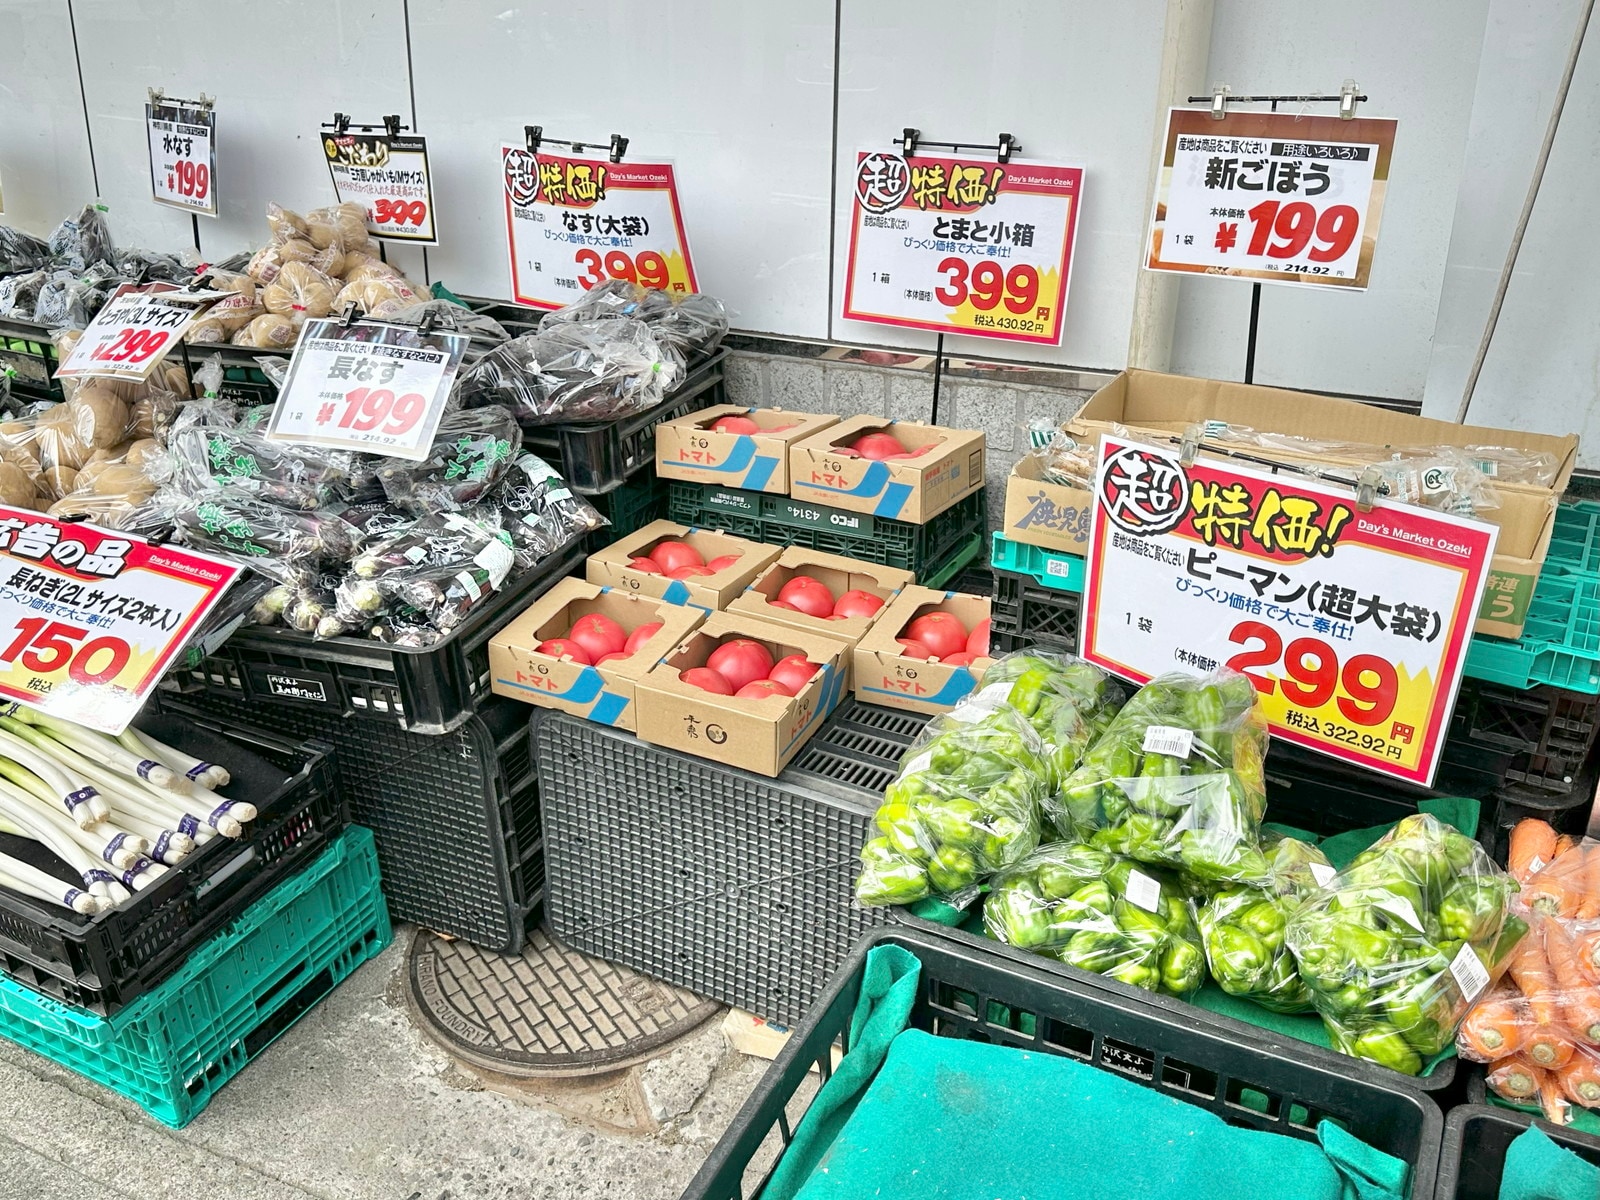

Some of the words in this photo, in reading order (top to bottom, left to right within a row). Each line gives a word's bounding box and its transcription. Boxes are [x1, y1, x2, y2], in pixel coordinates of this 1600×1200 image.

[163, 134, 193, 157] 水なす
[1178, 137, 1268, 155] 産地は商品をご覧ください
[504, 150, 538, 200] 超
[610, 172, 625, 180] Day's
[858, 154, 908, 209] 超
[1008, 175, 1026, 184] Day's
[1027, 176, 1052, 185] Market
[1053, 178, 1073, 187] Ozeki
[1204, 156, 1330, 196] 新ごぼう
[562, 211, 649, 236] なす(大袋)
[1209, 207, 1245, 219] 本体価格
[544, 230, 633, 247] びっくり価格で大ご奉仕!
[932, 216, 1035, 248] とまと小箱
[1175, 234, 1180, 244] 1
[1184, 234, 1195, 246] 袋
[903, 236, 1011, 258] びっくり価格で大ご奉仕!
[872, 272, 877, 282] 1
[880, 273, 890, 284] 箱
[1284, 263, 1330, 275] 214.92
[903, 289, 934, 302] (本体価格)
[327, 355, 404, 385] 長なす
[318, 391, 344, 401] 本体価格
[362, 434, 397, 445] 214.92
[680, 449, 716, 464] トマト
[811, 471, 848, 488] トマト
[1102, 449, 1186, 534] 超
[830, 514, 859, 528] IFCO
[1357, 517, 1391, 537] Day's
[1392, 527, 1435, 547] Market
[1436, 538, 1473, 557] Ozeki
[1112, 532, 1185, 568] 産地は商品をご覧ください
[149, 555, 171, 567] Day's
[171, 561, 199, 574] Market
[199, 568, 223, 580] Ozeki
[1187, 548, 1442, 643] ピーマン(超大袋)
[1176, 576, 1355, 642] びっくり価格で大ご奉仕!
[1125, 612, 1130, 625] 1
[1138, 617, 1153, 634] 袋
[0, 617, 131, 686] 150
[26, 677, 53, 694] 税込
[516, 670, 558, 691] トマト
[881, 675, 927, 695] トマト
[791, 710, 812, 739] トマト
[418, 956, 437, 995] HIRANO
[434, 999, 487, 1043] FOUNDRY
